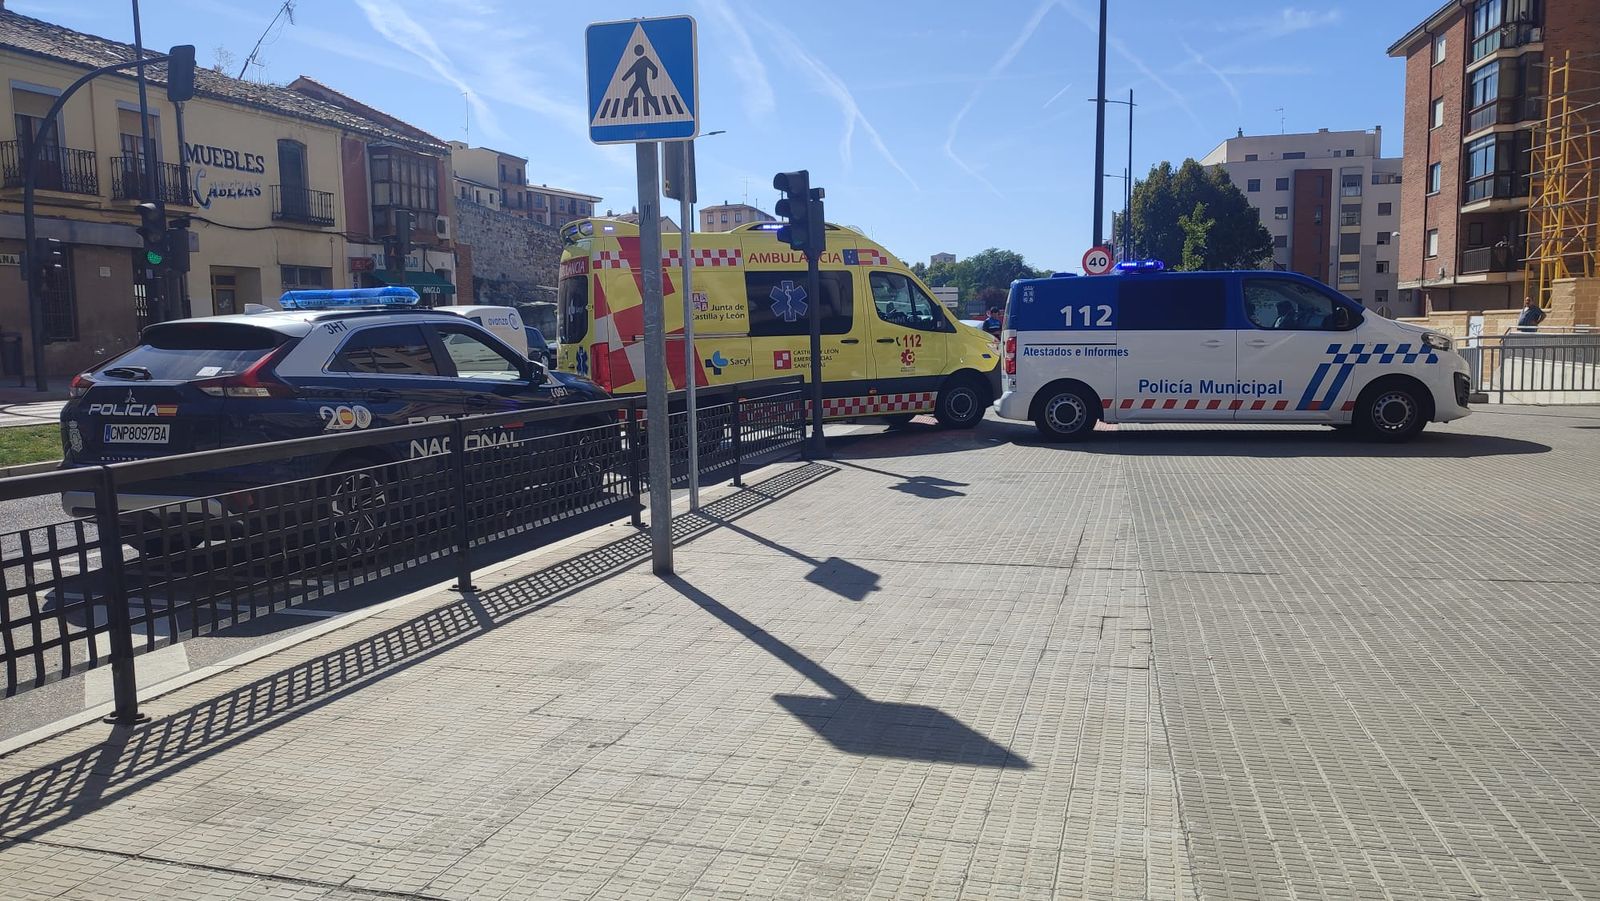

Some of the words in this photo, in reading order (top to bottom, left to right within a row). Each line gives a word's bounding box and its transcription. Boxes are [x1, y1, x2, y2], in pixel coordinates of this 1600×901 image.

[185, 142, 265, 174] MUEBLES
[748, 252, 842, 264] AMBULACIA
[1089, 257, 1107, 267] 40
[422, 286, 441, 294] ANGLO
[734, 303, 745, 311] de
[726, 311, 746, 320] León
[1060, 304, 1113, 327] 112
[323, 321, 348, 335] 3HT
[903, 334, 922, 348] 112
[1023, 346, 1073, 357] Atestados
[1075, 348, 1082, 357] e
[1084, 346, 1129, 357] Informes
[730, 357, 751, 367] Sacyl
[554, 387, 569, 397] 091
[1138, 379, 1193, 394] Policía
[1200, 379, 1283, 397] Municipal
[88, 403, 159, 417] POLICIA
[110, 426, 167, 442] CNP8097BA
[410, 432, 525, 460] NACONAL
